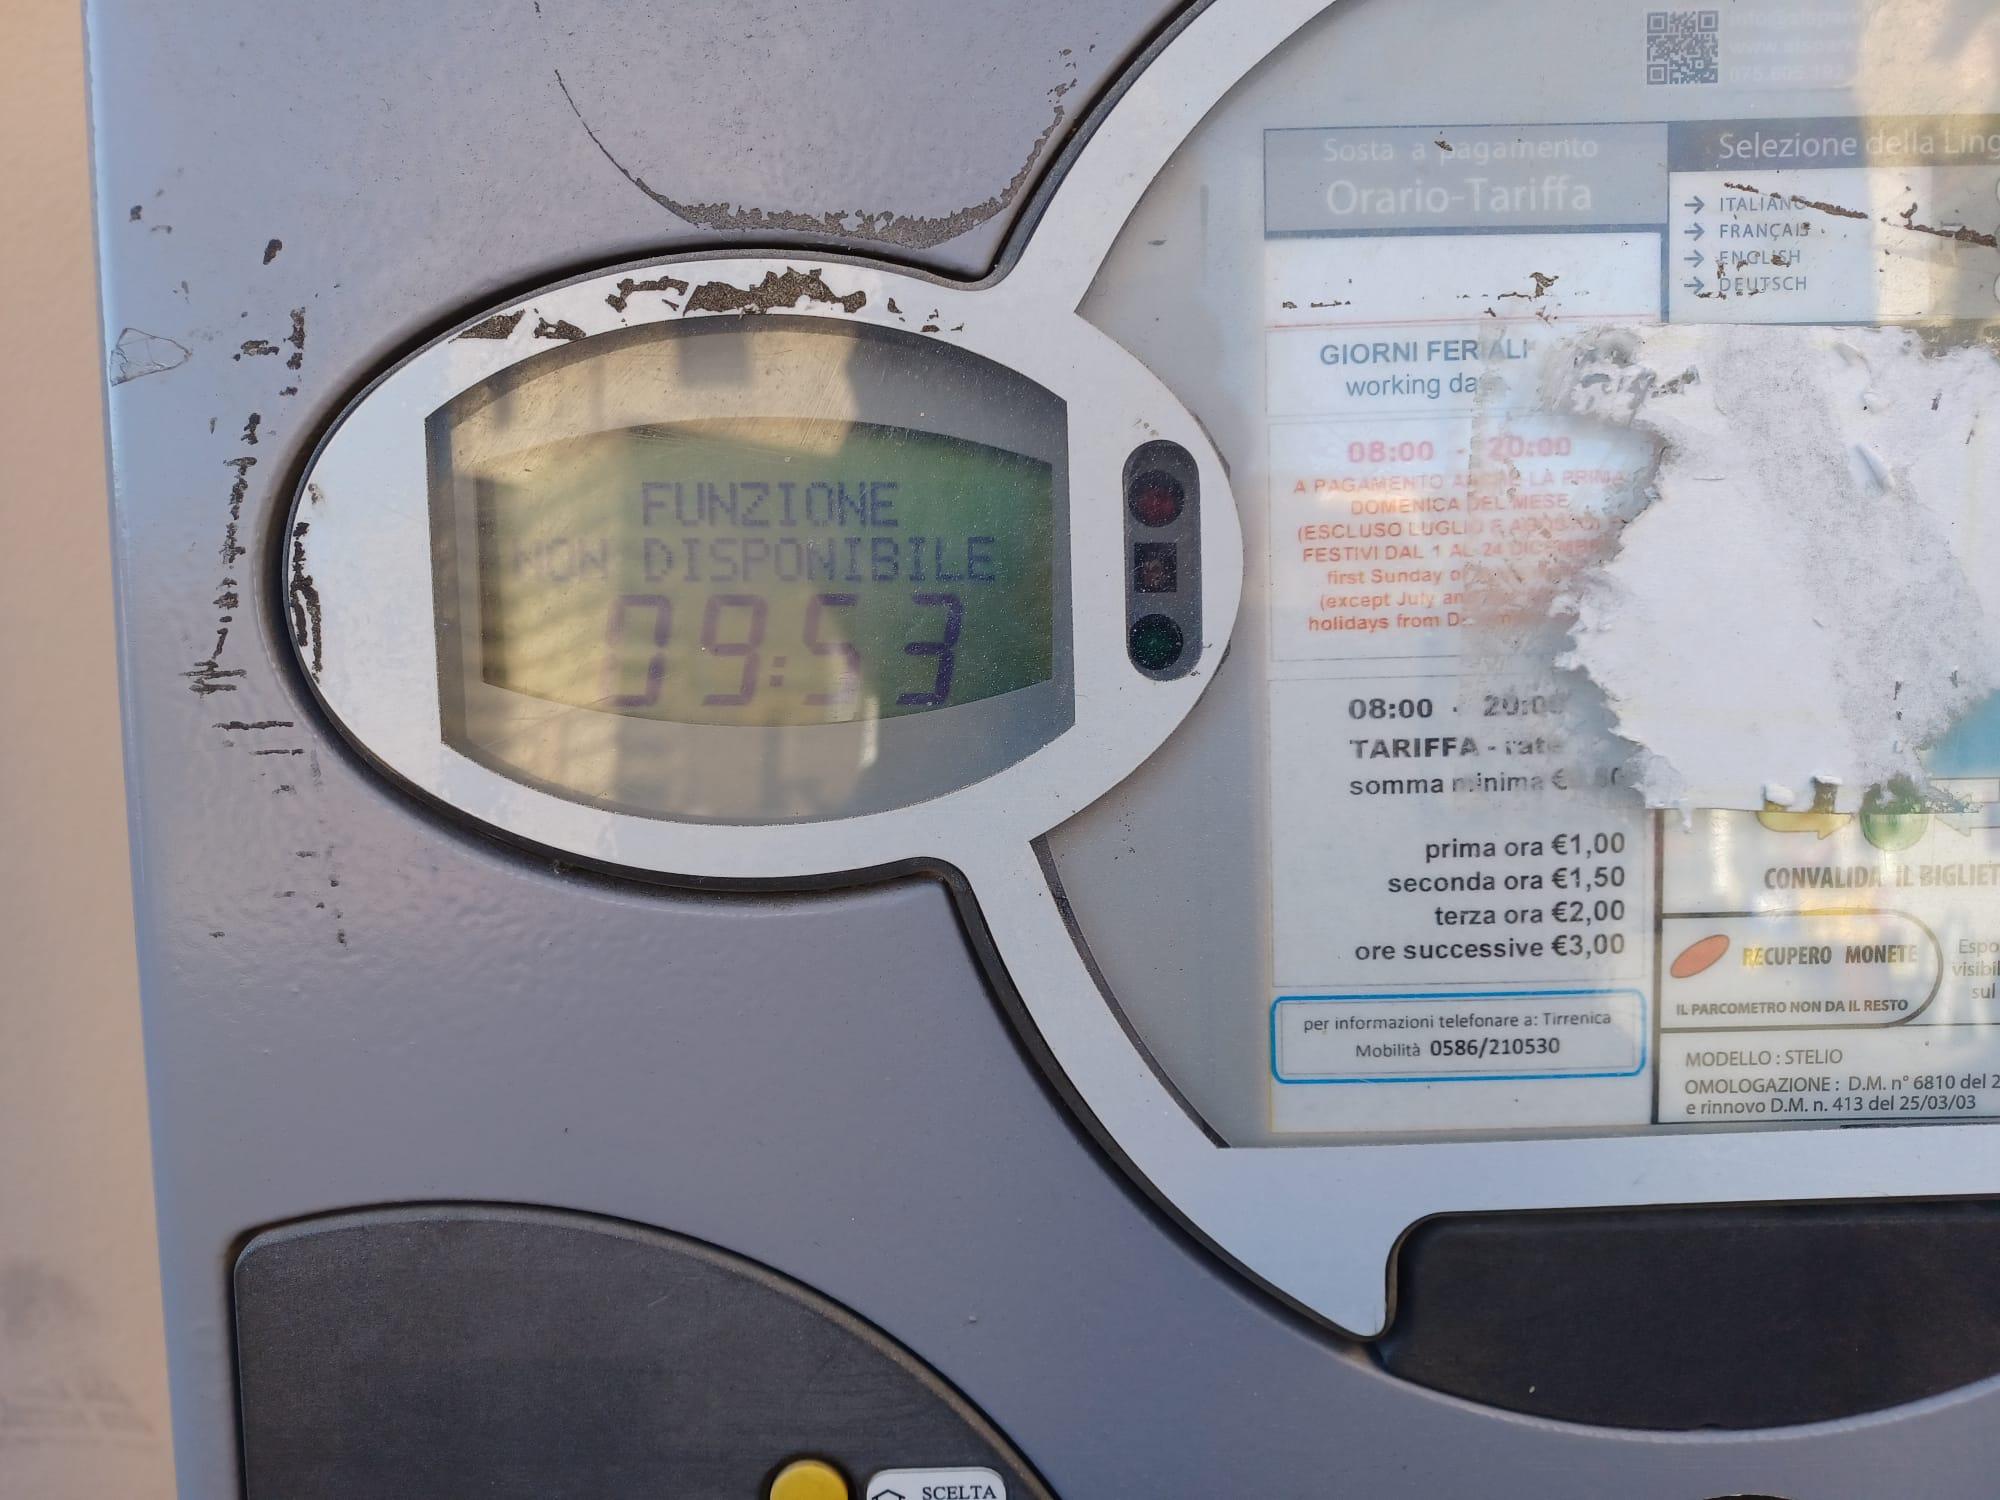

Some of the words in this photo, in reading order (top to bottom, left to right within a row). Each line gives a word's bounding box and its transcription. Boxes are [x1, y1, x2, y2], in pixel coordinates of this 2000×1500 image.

[1324, 138, 1393, 162] Sosta
[1412, 143, 1425, 161] a
[1440, 138, 1598, 167] pagamento
[1719, 131, 1857, 160] Selezione
[1866, 128, 1934, 155] della
[1327, 175, 1592, 215] Orario-Tariffa
[1720, 276, 1807, 292] DEUTSCH
[1320, 340, 1417, 366] GIORNI
[1427, 338, 1528, 361] FERALI
[1347, 373, 1441, 399] working
[1449, 372, 1478, 393] da
[1348, 441, 1434, 463] 08:00
[1488, 436, 1572, 461] 20:00
[1294, 479, 1307, 494] A
[1313, 475, 1443, 493] PAGAMENTO
[641, 481, 899, 527] FUNZIONE
[1351, 497, 1460, 516] DOMENICA
[1298, 521, 1402, 543] (ESCLUSO
[644, 535, 997, 583] DISPONIBILE
[1302, 545, 1383, 563] FESTIVI
[1385, 544, 1424, 561] DAL
[1433, 543, 1441, 559] 1
[1450, 542, 1473, 558] AL
[1327, 568, 1365, 586] first
[1370, 567, 1443, 590] Sunday
[1319, 591, 1391, 612] (except
[1397, 590, 1434, 610] July
[1308, 613, 1389, 634] holidays
[1396, 612, 1440, 629] from
[1348, 697, 1434, 720] 08:00
[1349, 737, 1480, 760] TARIFFA
[1349, 777, 1444, 797] somma
[1425, 838, 1496, 864] prima
[1504, 840, 1543, 858] ora
[1551, 832, 1625, 858] €1,00
[1388, 871, 1495, 893] seconda
[1504, 874, 1543, 891] ora
[1551, 866, 1625, 892] €1,50
[1764, 865, 1883, 890] CONVALIDA
[1895, 865, 1914, 887] IL
[1435, 906, 1495, 926] terza
[1504, 908, 1543, 925] ora
[1551, 900, 1625, 926] €2,00
[1355, 944, 1395, 962] ore
[1403, 940, 1543, 960] successive
[1551, 933, 1625, 959] €3,00
[1743, 946, 1832, 966] RECUPERO
[1845, 944, 1917, 964] MONETE
[1971, 982, 1996, 999] sul
[1677, 1003, 1688, 1016] IL
[1691, 1001, 1786, 1016] PARCOMETRO
[1790, 1000, 1822, 1013] NON
[1825, 1000, 1846, 1012] DA
[1848, 1000, 1861, 1012] IL
[1864, 999, 1908, 1012] RESTO
[1304, 1018, 1328, 1032] per
[1335, 1014, 1434, 1030] informazioni
[1439, 1012, 1519, 1029] telefonare
[1524, 1014, 1538, 1027] a:
[1542, 1011, 1612, 1027] Tirrenica
[1355, 1041, 1420, 1058] Mobilità
[1430, 1037, 1560, 1059] 0586/210530
[1686, 1051, 1772, 1067] MODELLO
[1785, 1049, 1843, 1065] STELIO
[1685, 1077, 1831, 1095] OMOLOGAZIONE
[1848, 1075, 1886, 1091] D.M.
[1913, 1075, 1955, 1090] 6810
[1960, 1073, 1986, 1089] del
[1686, 1104, 1696, 1115] e
[1701, 1099, 1765, 1114] rinnovo
[1771, 1098, 1808, 1114] D.M.
[1813, 1101, 1828, 1113] n.
[1832, 1097, 1863, 1112] 413
[1868, 1095, 1894, 1111] del
[1900, 1094, 1976, 1111] 25/03/03
[922, 1485, 997, 1500] SCELTA
